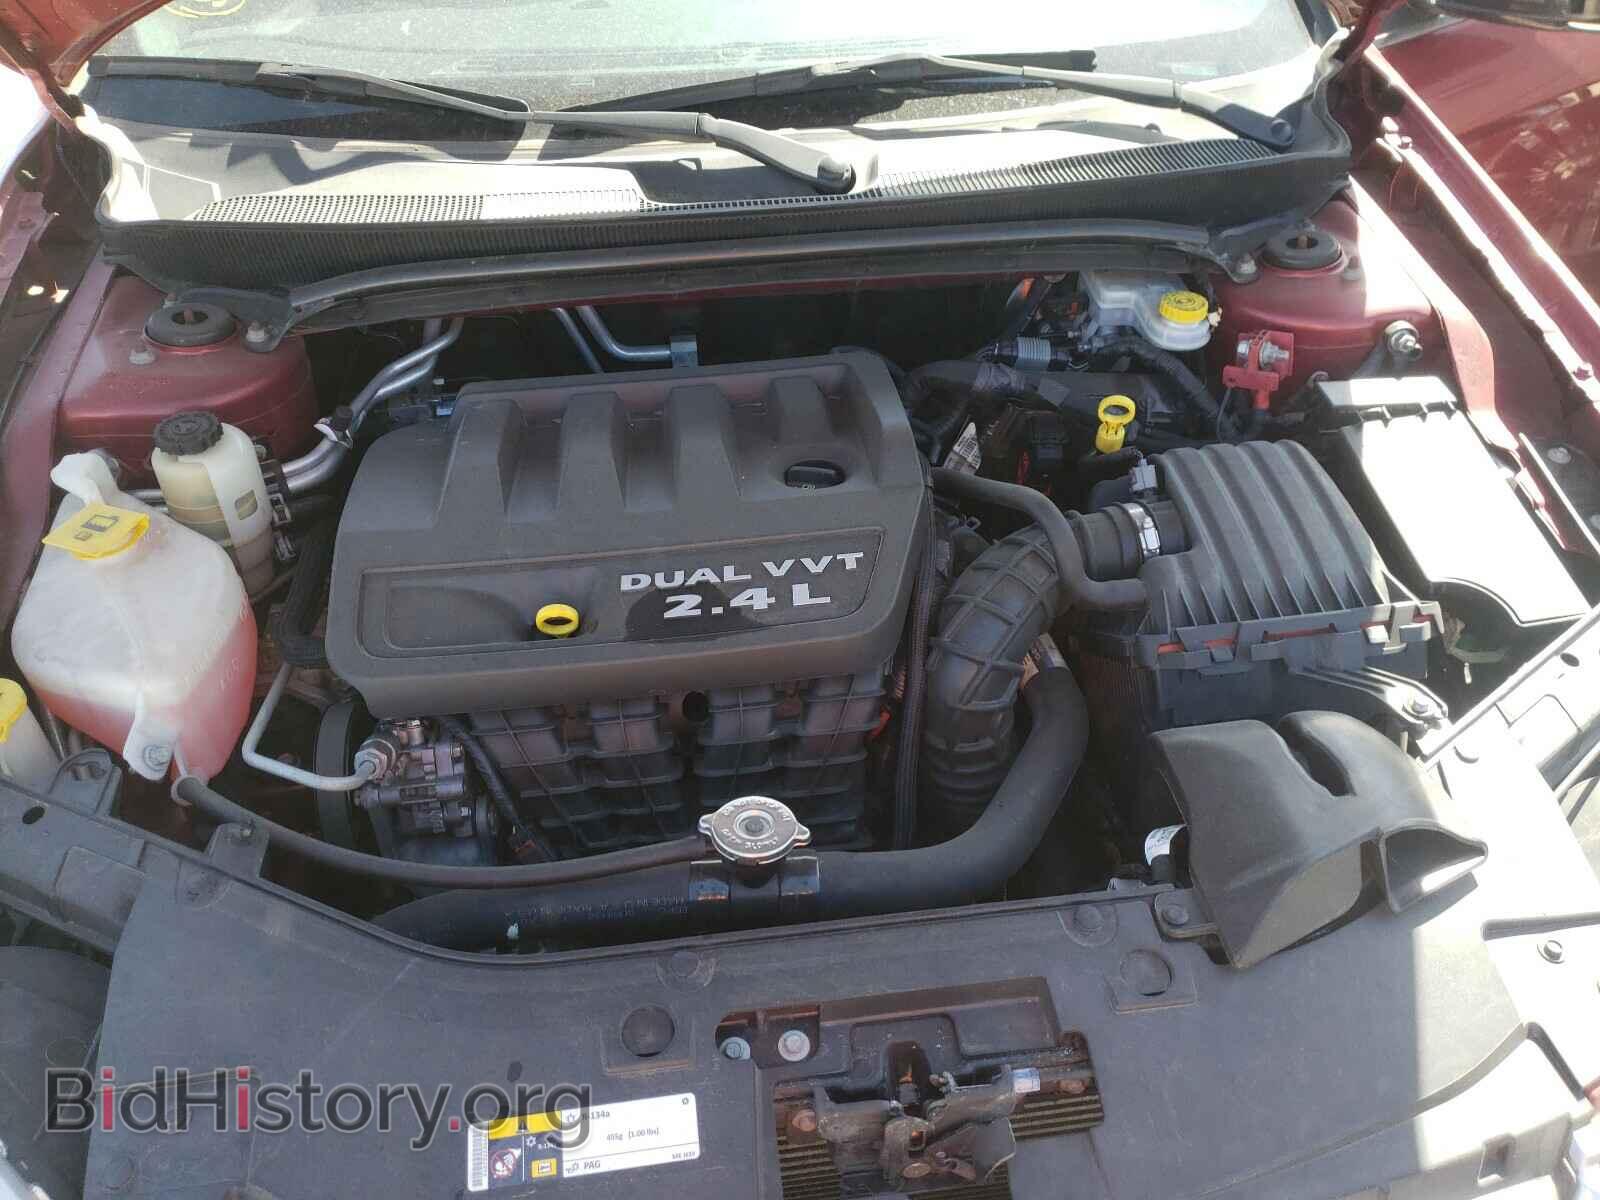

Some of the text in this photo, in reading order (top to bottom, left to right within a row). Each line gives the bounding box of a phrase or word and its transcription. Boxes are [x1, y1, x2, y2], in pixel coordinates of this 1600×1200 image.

[620, 551, 864, 592] DUAL VVT
[663, 583, 831, 619] 2.4 L
[583, 1160, 601, 1169] PAG
